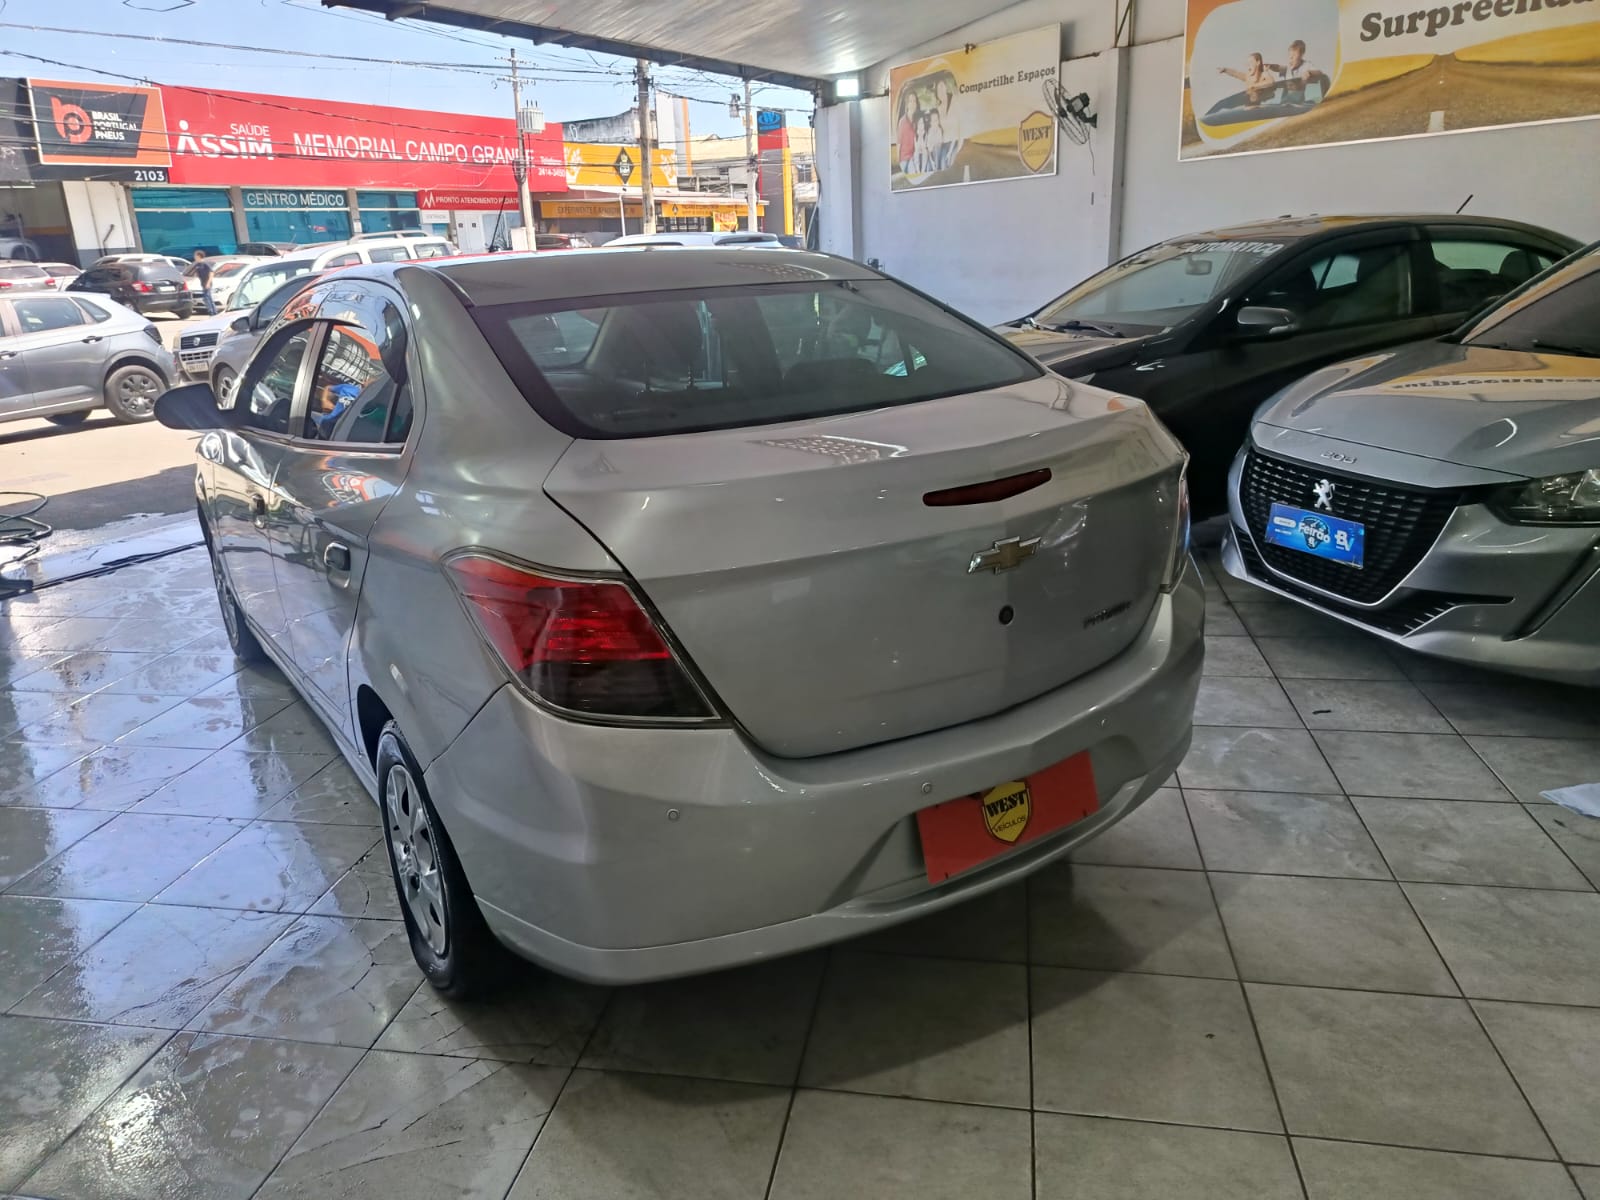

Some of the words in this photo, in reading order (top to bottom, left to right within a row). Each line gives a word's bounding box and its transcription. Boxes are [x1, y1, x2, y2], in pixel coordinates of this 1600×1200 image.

[960, 74, 1014, 94] Compartilhe
[1018, 66, 1056, 83] Espaços
[91, 111, 123, 122] BRASIL
[94, 131, 125, 141] PNEUS
[230, 122, 270, 137] SAÚDE
[1022, 125, 1052, 142] WEST
[293, 132, 402, 160] MEMORIAL
[405, 140, 468, 163] CAMPO
[134, 170, 165, 181] 2103
[247, 192, 298, 206] CENTRO
[300, 191, 344, 206] MÉDICO
[436, 196, 459, 204] PRONTO
[461, 196, 498, 204] ATENDIMENTO
[986, 789, 1028, 817] WEST
